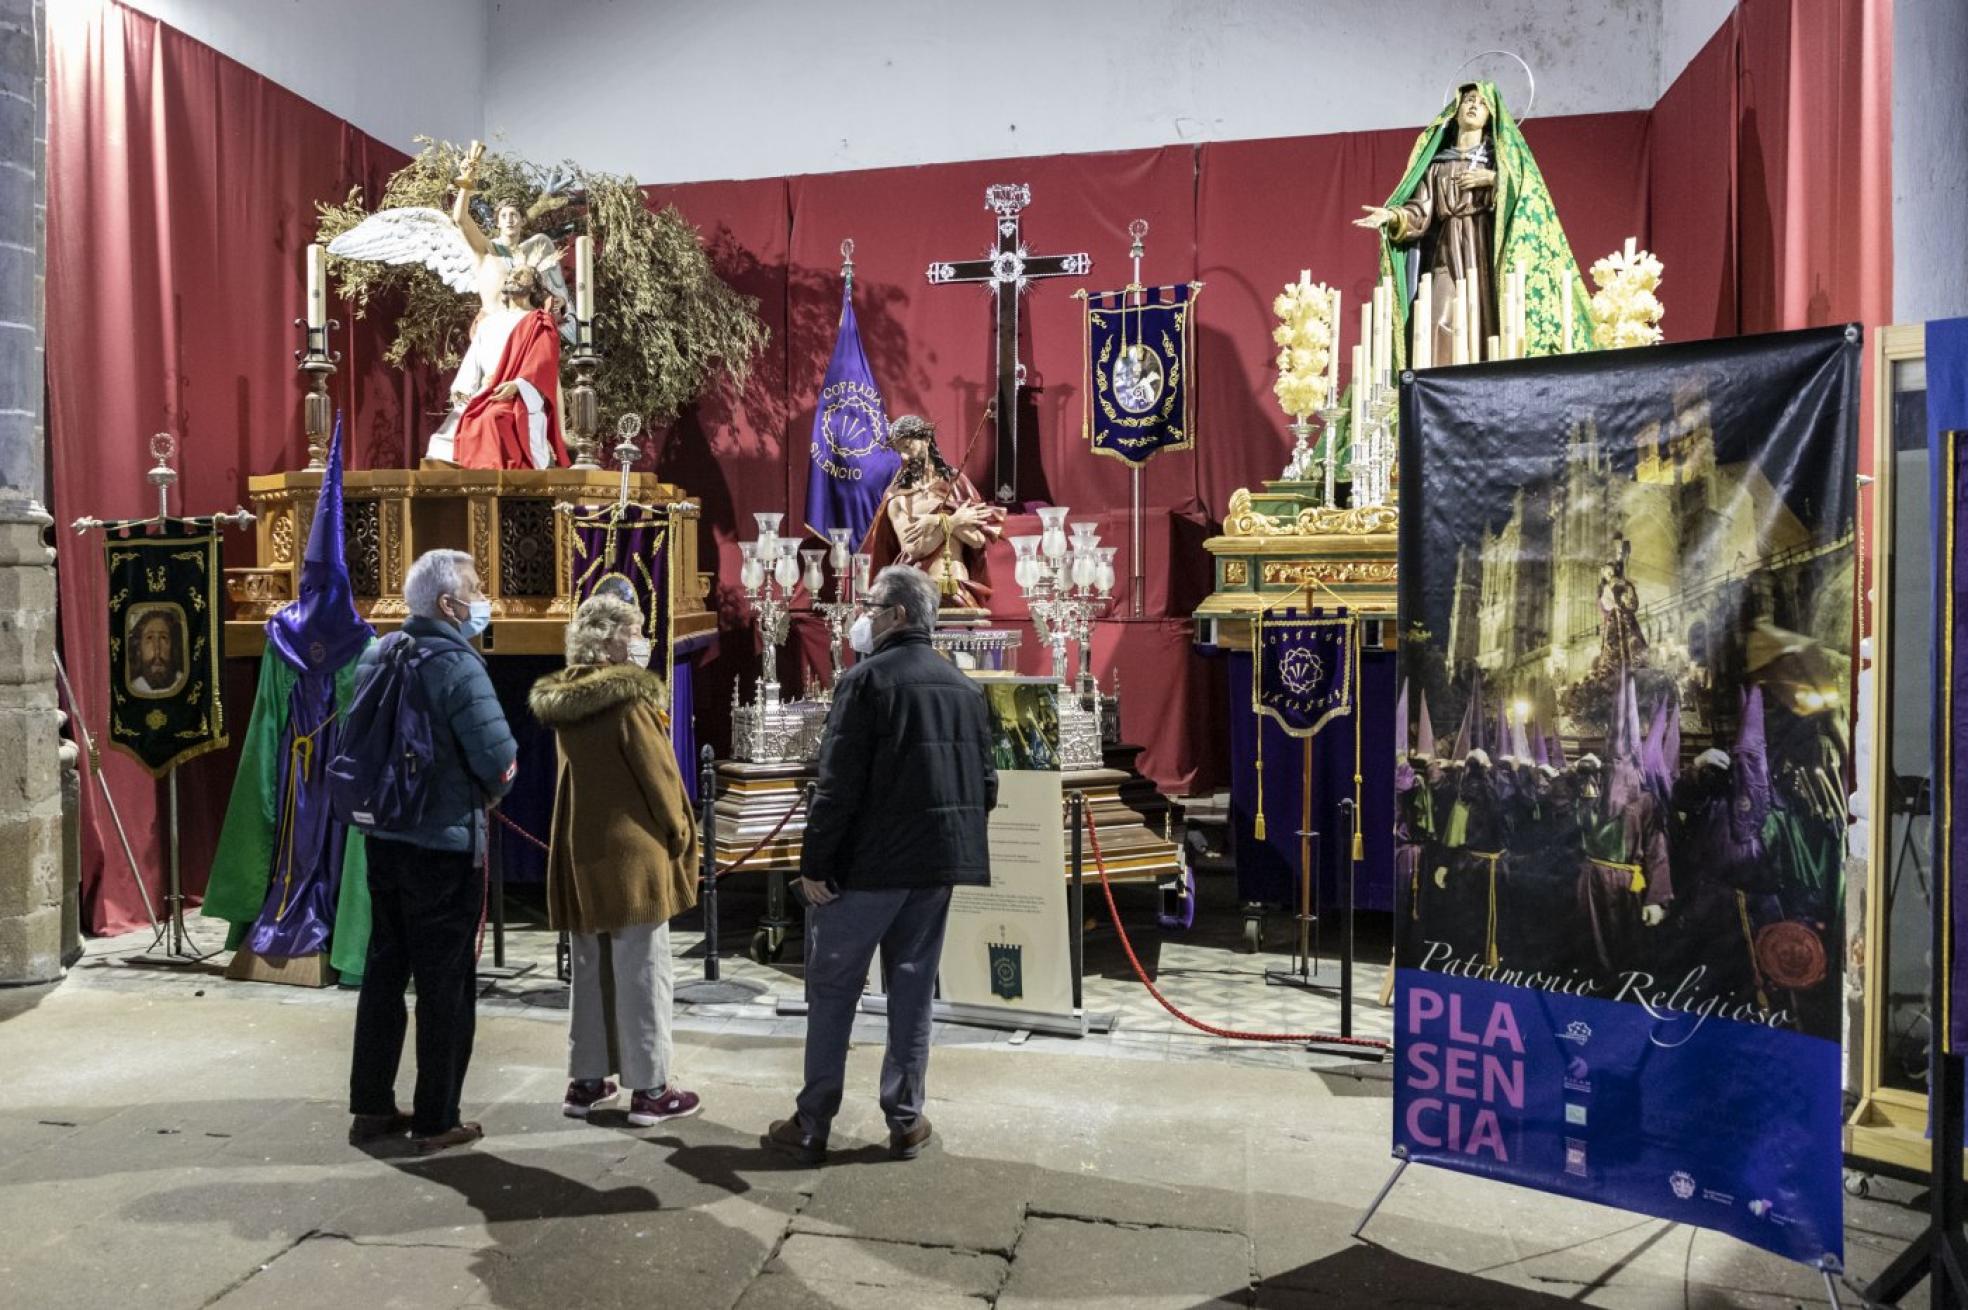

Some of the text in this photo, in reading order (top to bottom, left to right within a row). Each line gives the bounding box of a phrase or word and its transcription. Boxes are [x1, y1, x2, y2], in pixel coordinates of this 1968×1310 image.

[810, 442, 863, 480] SILENCIO
[1408, 987, 1526, 1054] PLA
[1419, 939, 1798, 1048] Patrimonio Religioso
[1406, 1041, 1526, 1110] SEN
[1405, 1097, 1509, 1163] CIA
